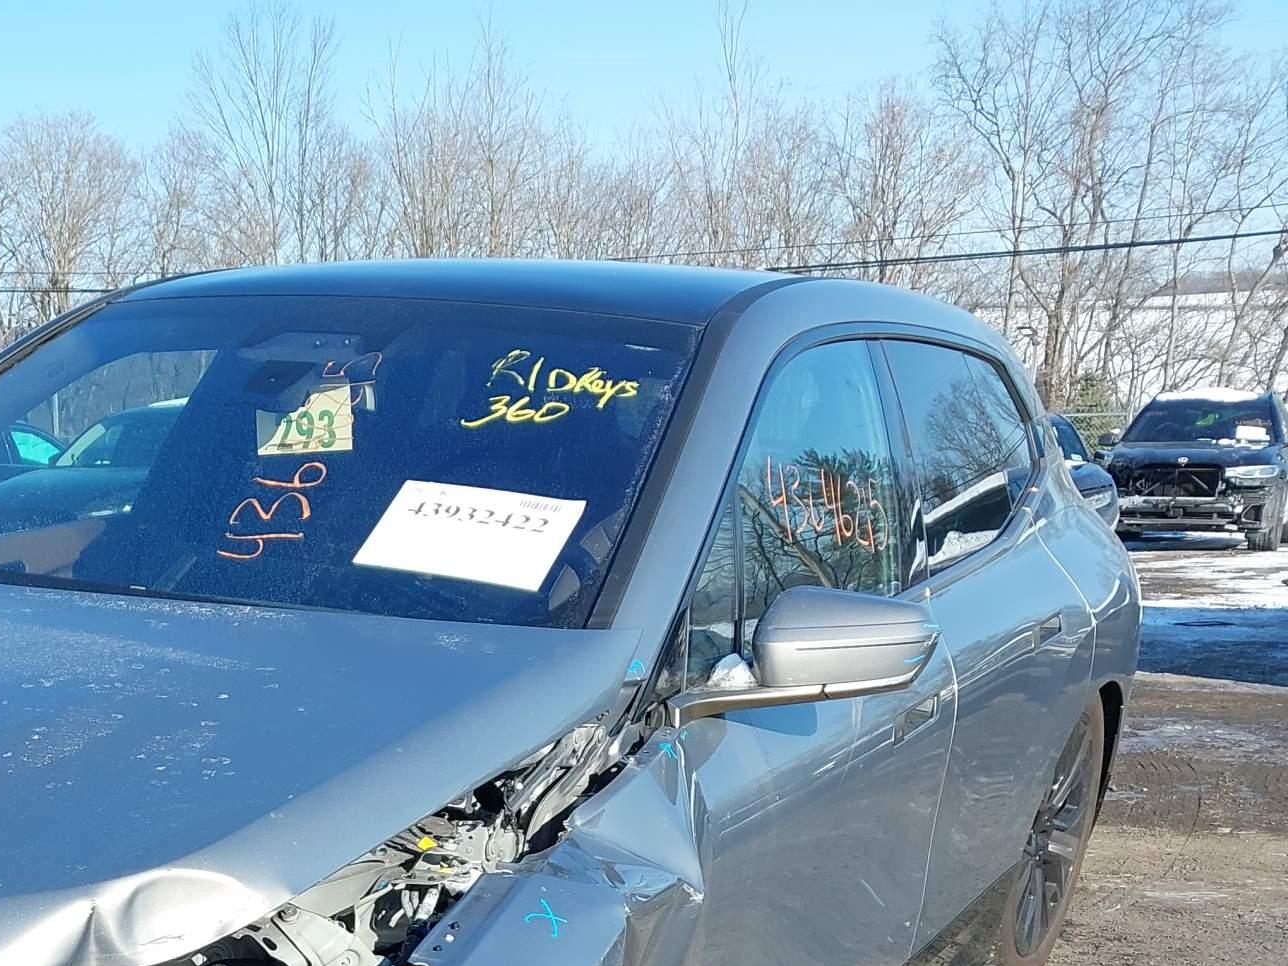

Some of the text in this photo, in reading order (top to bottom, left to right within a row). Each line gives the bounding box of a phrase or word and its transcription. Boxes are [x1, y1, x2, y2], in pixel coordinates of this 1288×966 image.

[460, 395, 570, 428] 360
[275, 409, 337, 449] 293
[408, 501, 549, 533] 43932422
